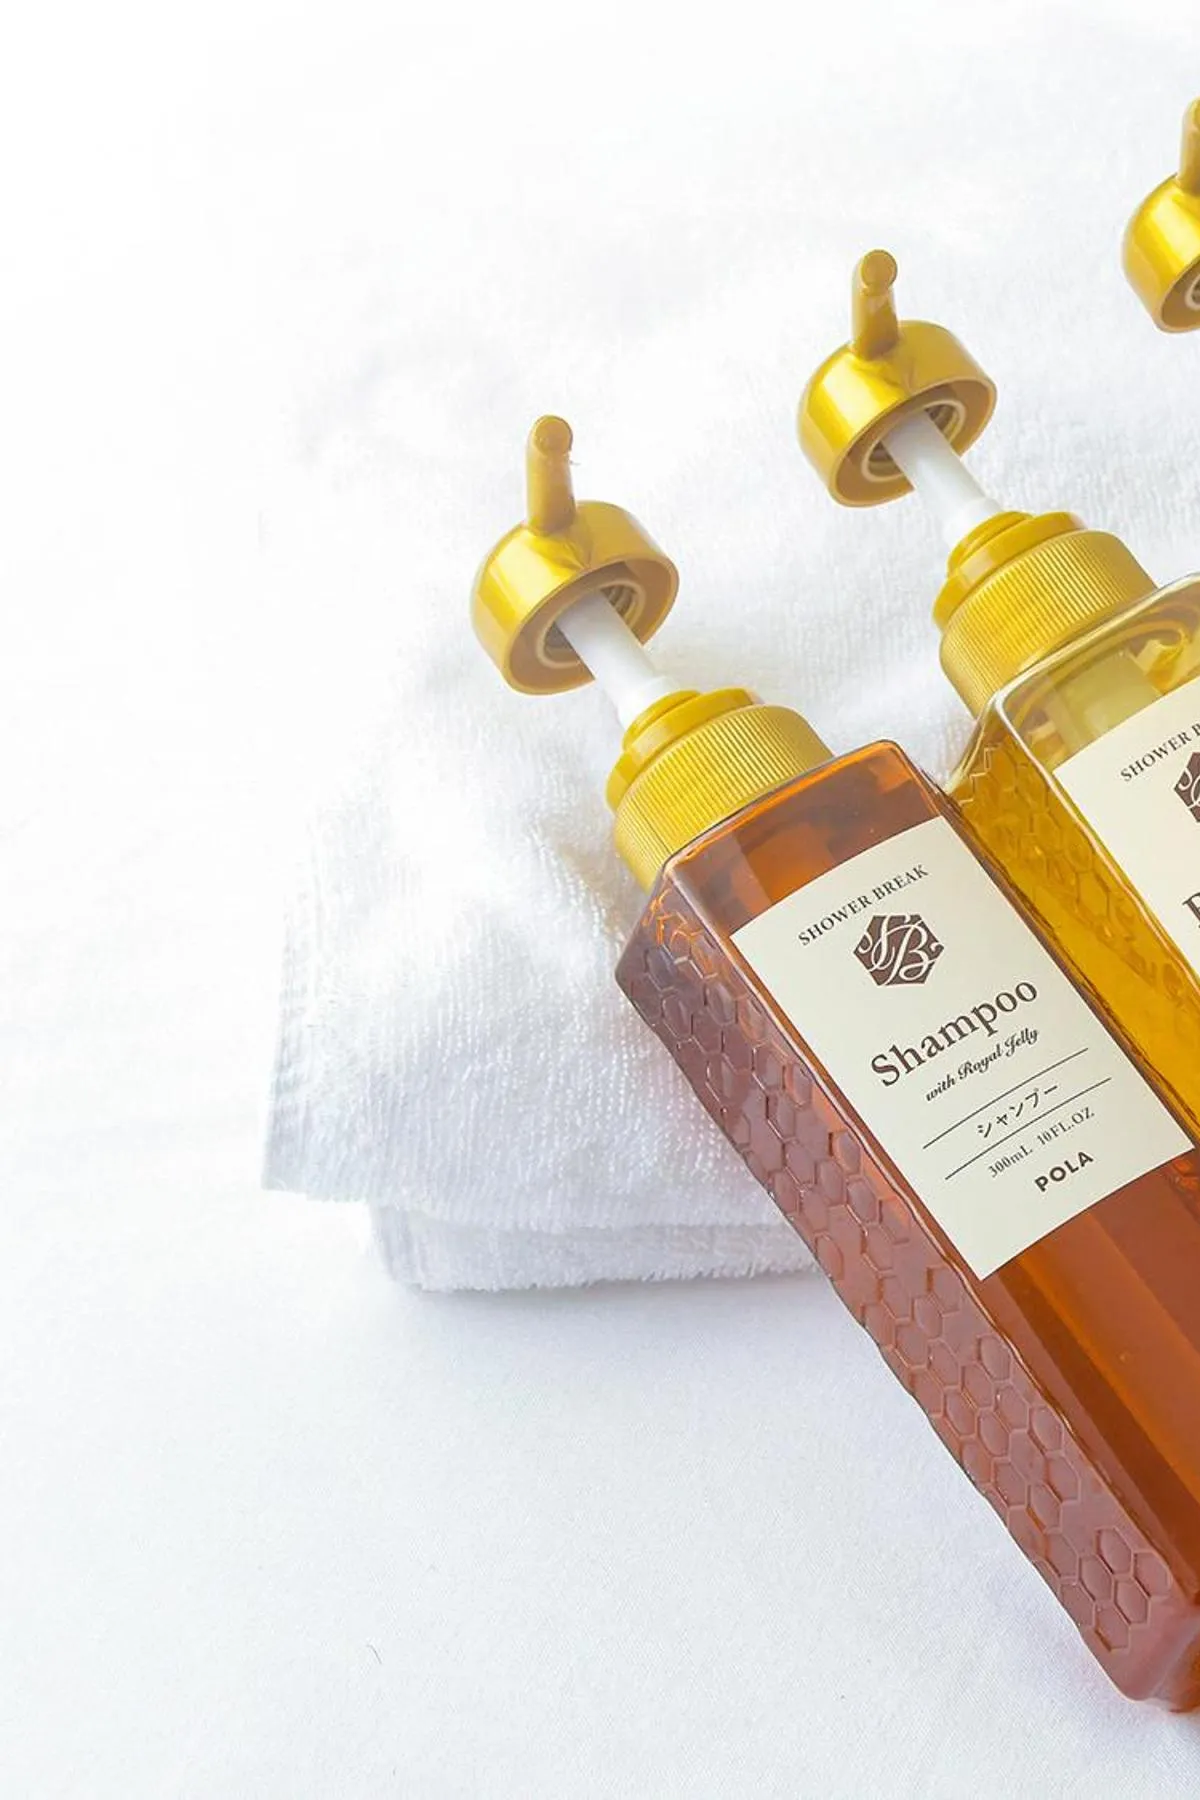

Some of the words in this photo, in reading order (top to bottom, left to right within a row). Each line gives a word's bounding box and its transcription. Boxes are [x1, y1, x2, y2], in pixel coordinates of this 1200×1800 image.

[1120, 731, 1192, 781] SHOWER
[798, 895, 872, 946] SHOWER
[872, 864, 929, 899] BREAK
[871, 981, 1038, 1086] Shampoo
[926, 1076, 956, 1102] with
[957, 1048, 1002, 1080] Royal
[1004, 1027, 1039, 1058] Jelly
[977, 1085, 1058, 1138] シャンプー
[1034, 1151, 1094, 1192] POLA
